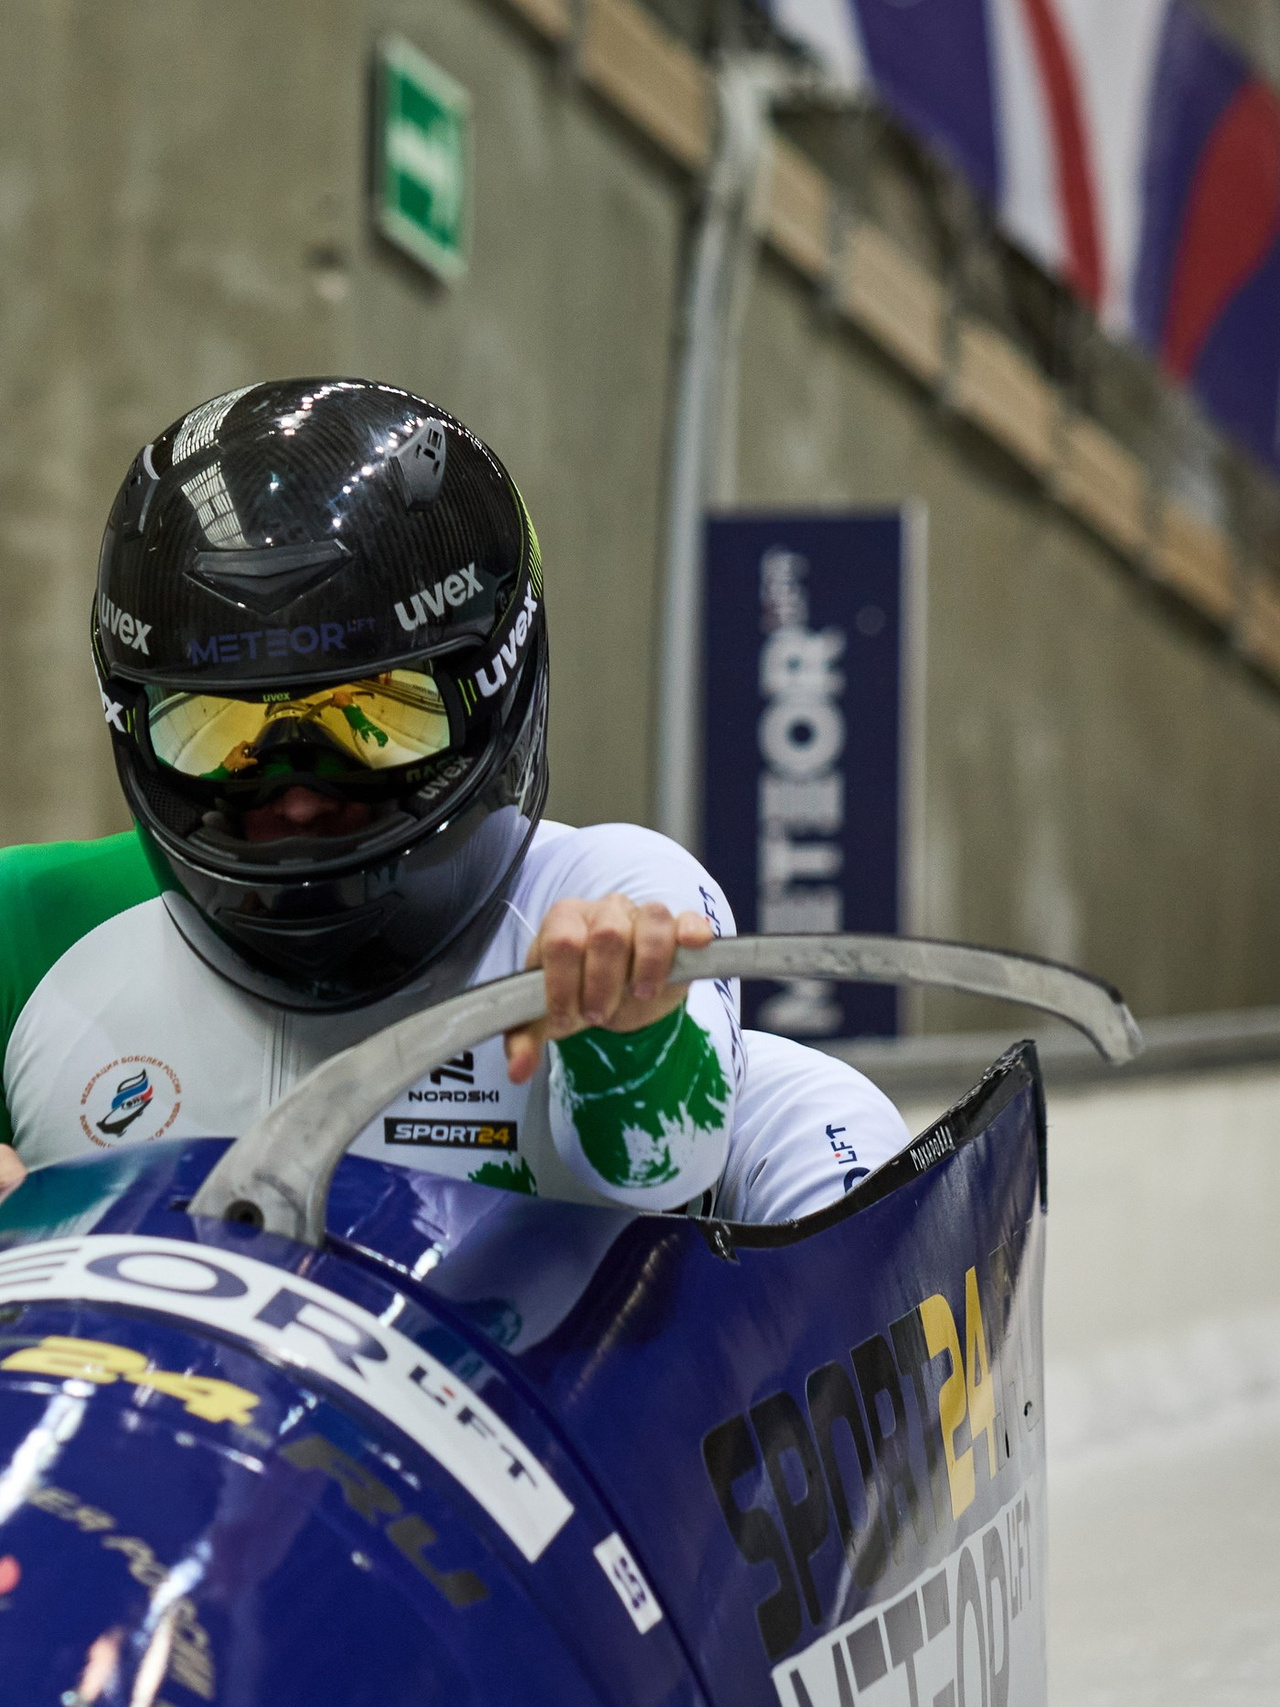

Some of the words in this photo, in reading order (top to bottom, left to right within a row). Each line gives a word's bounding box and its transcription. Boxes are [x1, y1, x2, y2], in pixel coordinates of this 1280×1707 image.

[394, 562, 484, 632] uvex
[99, 596, 153, 656] uvex
[189, 622, 347, 667] METEOR
[475, 581, 538, 698] uvex
[262, 692, 291, 703] uvex
[418, 754, 473, 800] uvex
[408, 1090, 500, 1104] NORDSKI
[393, 1123, 511, 1145] SPORT24
